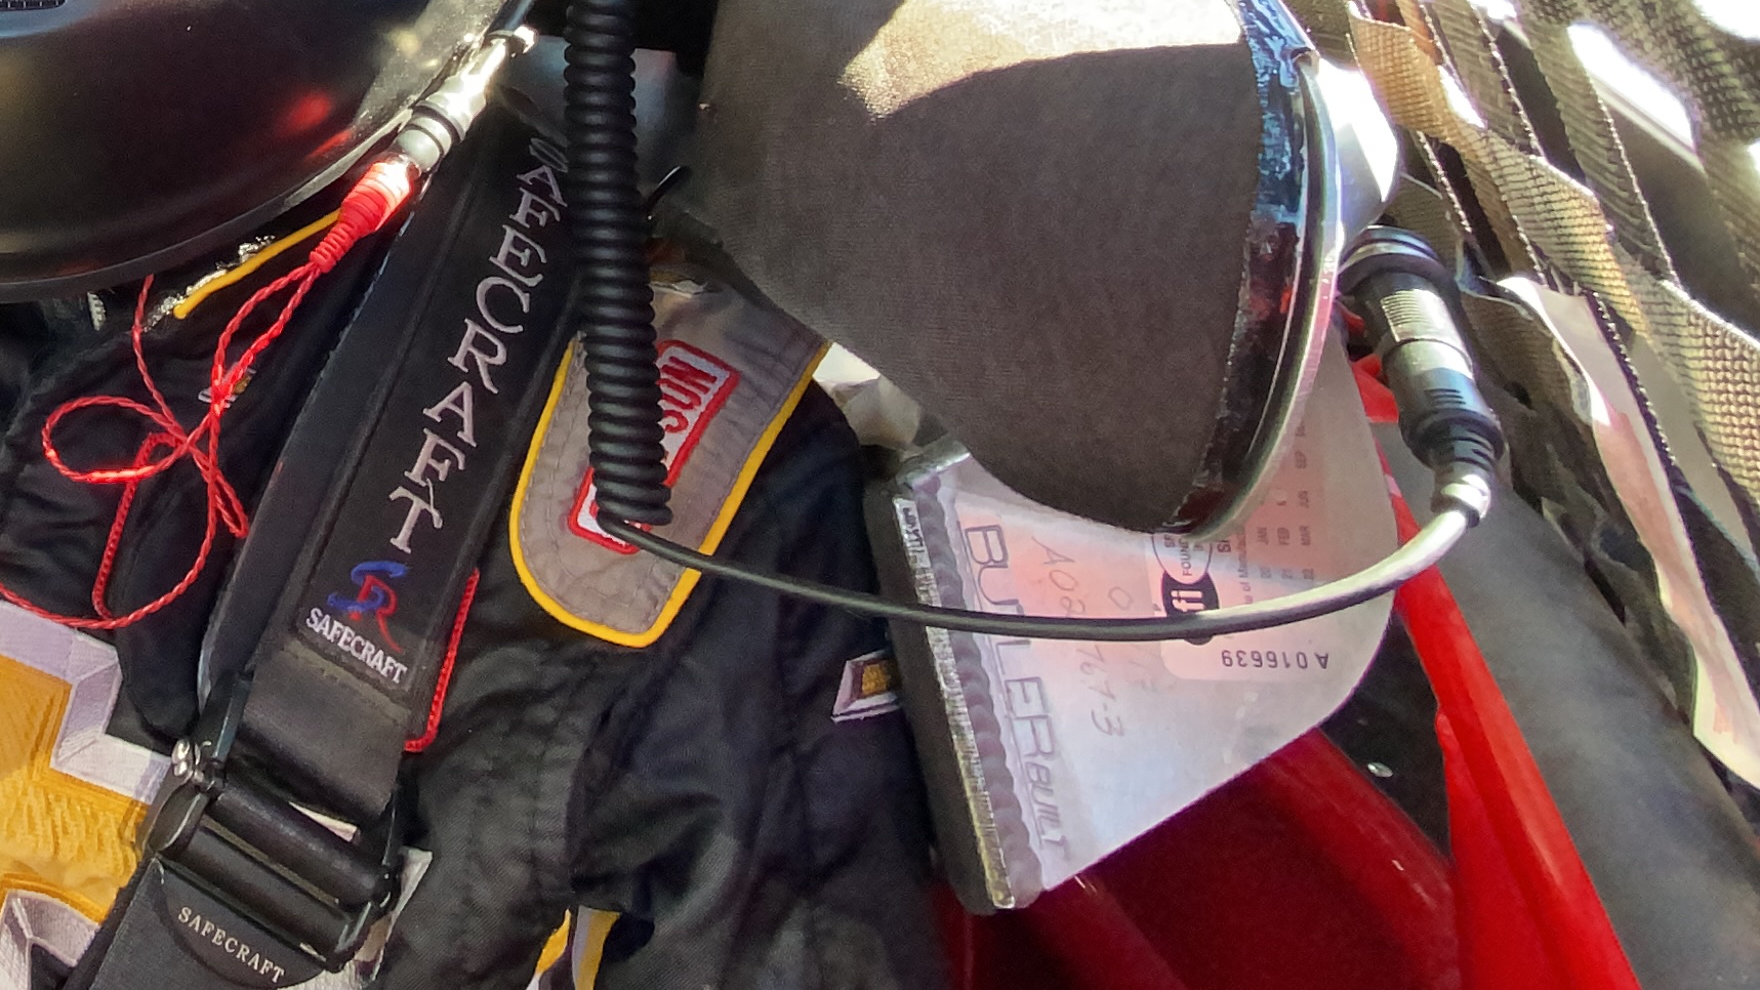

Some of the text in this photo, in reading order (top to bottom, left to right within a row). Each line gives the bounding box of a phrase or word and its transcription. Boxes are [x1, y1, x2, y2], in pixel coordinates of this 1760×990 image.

[1170, 589, 1206, 613] fi
[305, 607, 408, 684] SAFECRAFT
[178, 906, 285, 983] SAFECRAFT
